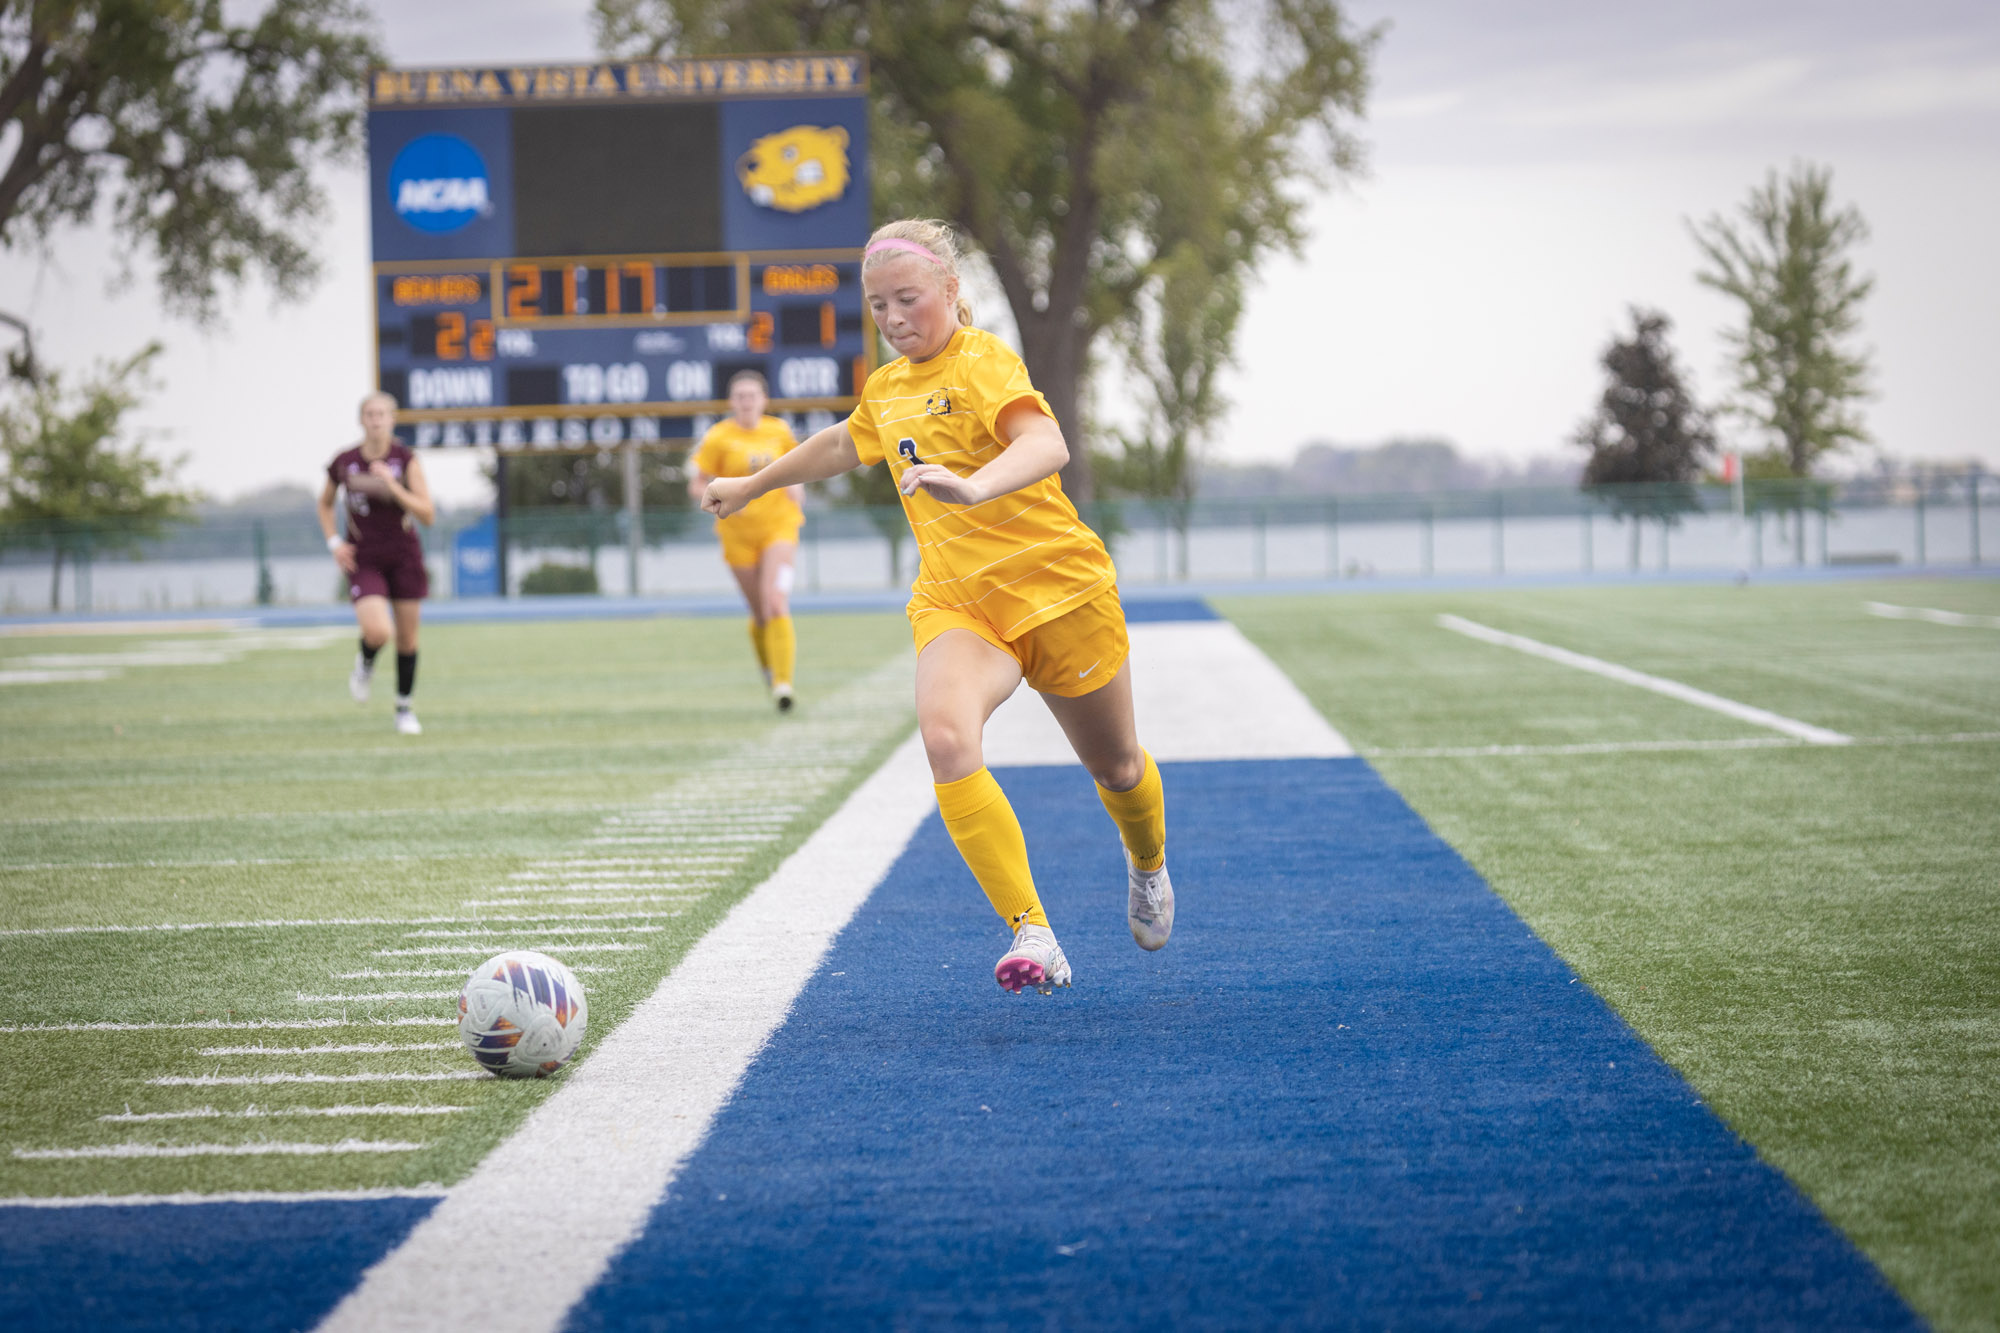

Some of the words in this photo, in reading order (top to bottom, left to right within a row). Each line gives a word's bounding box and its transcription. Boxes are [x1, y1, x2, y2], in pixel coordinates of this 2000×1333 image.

[374, 70, 502, 102] BUENA
[508, 66, 621, 99] VISTA
[626, 56, 859, 96] UNIVERSITY
[397, 177, 488, 214] NCAA
[747, 311, 774, 354] 2
[820, 302, 836, 349] 1
[409, 367, 493, 409] DOWN
[563, 363, 603, 404] TO
[606, 362, 648, 402] GO
[666, 360, 712, 400] ON
[779, 357, 839, 397] QTR
[415, 414, 660, 450] PETERSON
